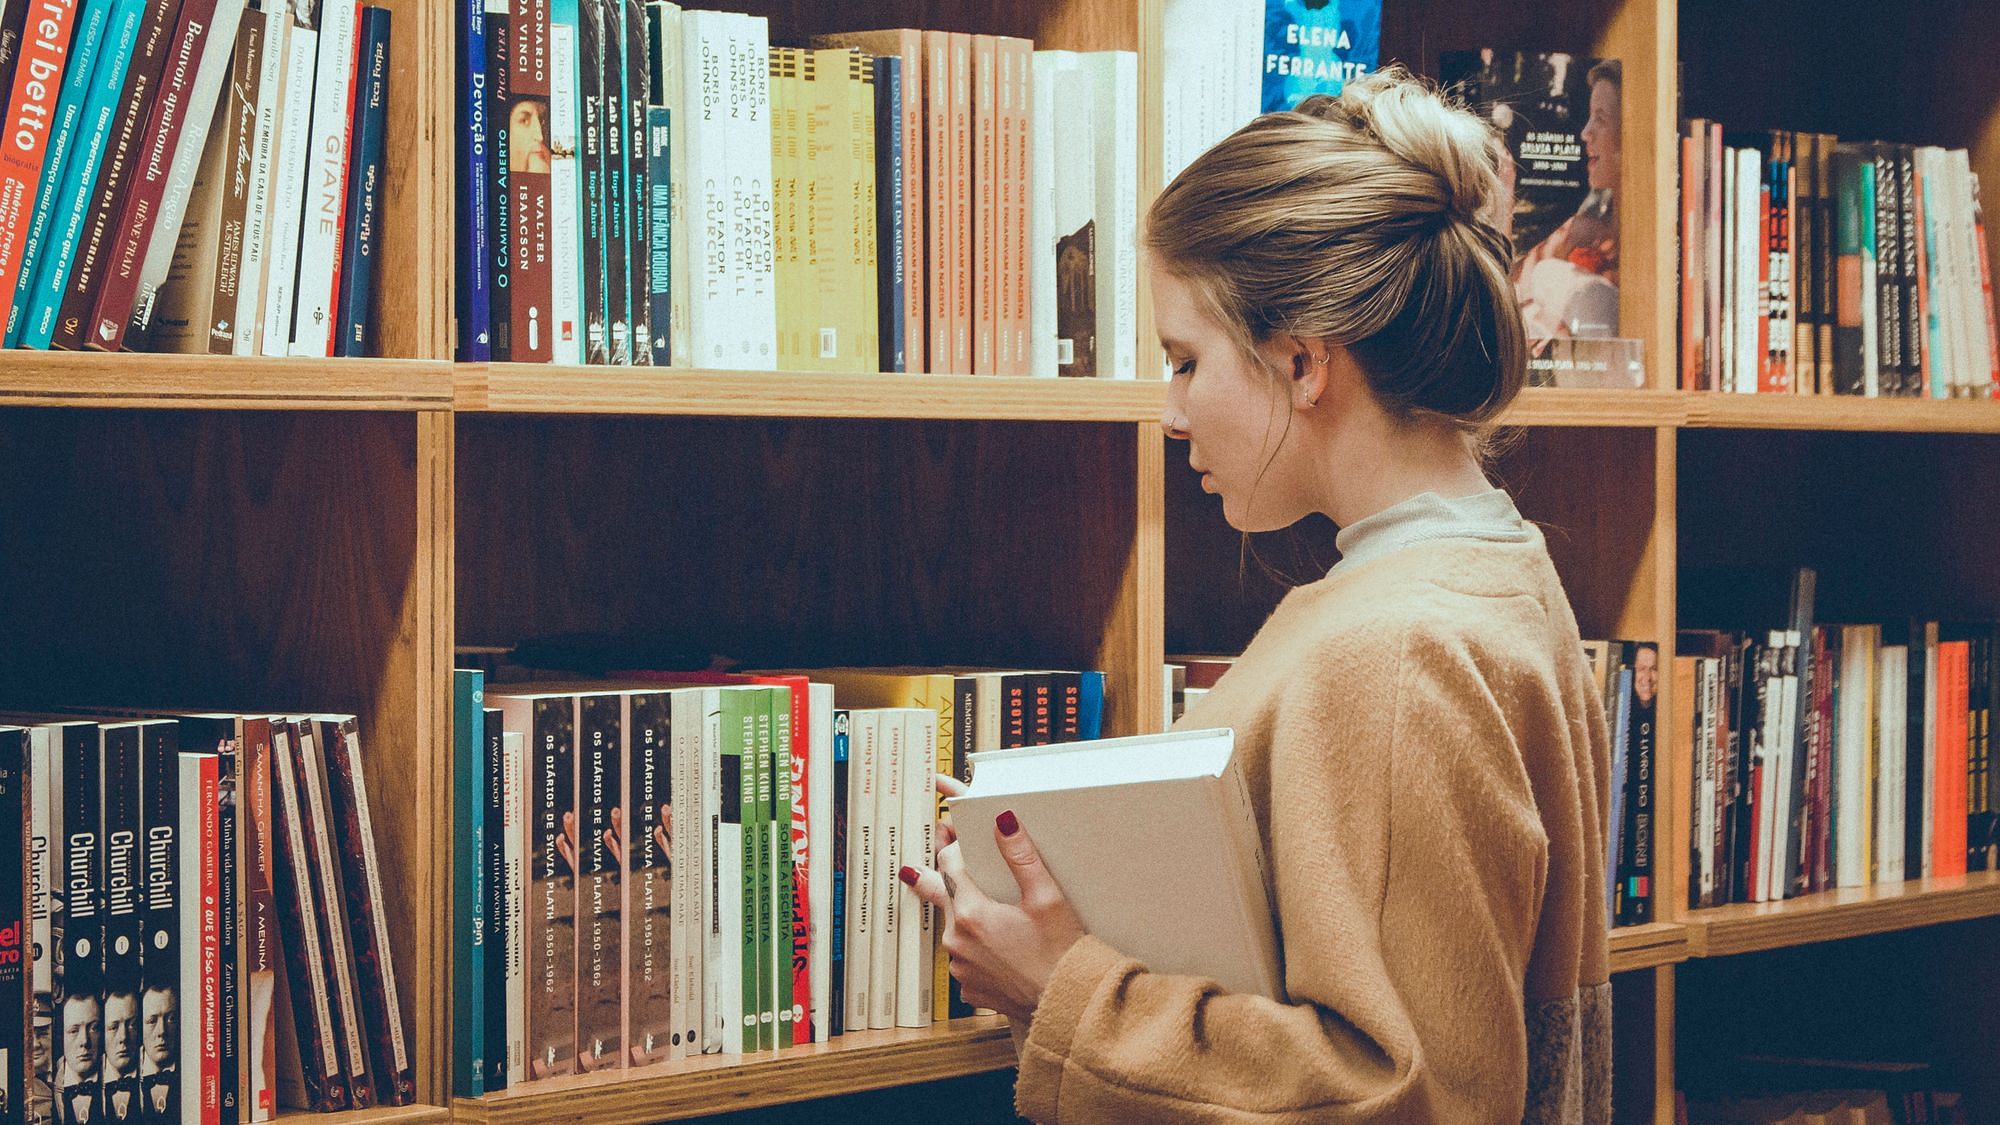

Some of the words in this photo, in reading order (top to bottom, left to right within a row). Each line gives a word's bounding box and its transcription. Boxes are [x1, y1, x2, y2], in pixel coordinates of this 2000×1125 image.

[84, 8, 102, 47] MELISSA
[119, 11, 136, 49] MELISSA
[1286, 24, 1351, 50] ELENA
[172, 19, 203, 90] Beauvoir
[372, 42, 384, 78] Forjaz
[519, 23, 528, 73] VINCI
[74, 48, 91, 88] FLEMING
[108, 50, 125, 90] FLEMING
[702, 36, 711, 121] JOHNSON
[711, 55, 720, 105] BORIS
[738, 53, 747, 102] BORIS
[1265, 54, 1367, 81] FERRANTE
[15, 58, 58, 151] betto
[264, 107, 272, 122] VAI
[370, 82, 380, 109] Teca
[470, 72, 485, 155] Devoção
[587, 96, 596, 123] Lab
[609, 96, 618, 123] Lab
[63, 104, 77, 131] Uma
[96, 106, 110, 132] Uma
[146, 92, 178, 182] apaixonada
[179, 124, 203, 174] Renato
[260, 124, 271, 160] EMBORA
[587, 126, 596, 155] Girl
[609, 126, 618, 155] Girl
[47, 130, 68, 184] esperança
[81, 132, 104, 185] esperança
[258, 163, 267, 175] DA
[498, 129, 507, 188] ABERTO
[40, 184, 56, 209] mais
[256, 178, 266, 201] CASA
[320, 134, 341, 237] GIANE
[365, 165, 375, 192] Gata
[589, 170, 597, 198] Hope
[652, 184, 669, 206] UMA
[75, 185, 90, 212] mais
[101, 190, 114, 208] DA
[162, 177, 187, 230] Aragão
[255, 204, 263, 215] DE
[364, 195, 373, 211] da
[716, 200, 724, 212] O
[743, 197, 752, 210] O
[32, 209, 50, 238] forte
[66, 213, 81, 240] forte
[231, 220, 241, 251] JAMES
[253, 219, 262, 240] TEUS
[498, 194, 508, 267] CAMINHO
[520, 185, 529, 271] ISAACSON
[536, 194, 544, 263] WALTER
[589, 201, 597, 239] Jahren
[652, 207, 669, 250] INFÂNCIA
[732, 176, 745, 297] CHURCHILL
[24, 238, 38, 259] que
[60, 239, 73, 260] que
[77, 212, 107, 293] LIBERDADE
[120, 240, 138, 278] FRAIN
[362, 244, 370, 256] O
[705, 179, 718, 301] CHURCHILL
[716, 221, 726, 275] FATOR
[743, 217, 753, 271] FATOR
[18, 266, 32, 291] mar
[52, 268, 65, 292] mar
[227, 252, 239, 297] EDWARD
[498, 274, 508, 288] O
[652, 251, 669, 294] ROUBADA
[964, 693, 974, 750] MEMÓRIAS
[1010, 688, 1022, 736] SCOTT
[1036, 687, 1048, 734] SCOTT
[1066, 687, 1077, 734] SCOTT
[1638, 722, 1649, 736] O
[492, 736, 500, 775] FAWZIA
[546, 735, 554, 750] OS
[593, 731, 602, 746] OS
[645, 729, 653, 744] OS
[743, 715, 754, 770] STEPHEN
[759, 714, 769, 769] STEPHEN
[779, 713, 789, 767] STEPHEN
[593, 751, 603, 804] DIÁRIOS
[645, 749, 655, 801] DIÁRIOS
[1638, 740, 1649, 781] LIVRO
[257, 743, 265, 817] SAMANTHA
[492, 777, 500, 808] KOOFI
[546, 756, 556, 808] DIÁRIOS
[743, 774, 754, 803] KING
[759, 772, 769, 802] KING
[779, 771, 789, 800] KING
[1638, 784, 1649, 808] DO
[205, 779, 214, 837] FERNANDO
[546, 814, 554, 829] DE
[593, 809, 602, 824] DE
[645, 806, 653, 821] DE
[223, 818, 233, 850] Minha
[257, 821, 265, 872] GEIMER
[593, 829, 602, 871] SYLVIA
[645, 826, 653, 868] SYLVIA
[744, 826, 753, 871] SOBRE
[760, 824, 769, 869] SOBRE
[110, 831, 133, 916] Churchill
[206, 840, 214, 887] GABEIRA
[223, 852, 233, 874] vida
[546, 834, 554, 877] SYLVIA
[71, 832, 94, 918] Churchill
[223, 876, 233, 905] como
[645, 873, 653, 910] PLATH
[744, 875, 753, 885] A
[760, 873, 769, 883] A
[205, 895, 215, 905] O
[257, 902, 264, 912] A
[546, 882, 554, 920] PLATH
[593, 876, 602, 914] PLATH
[205, 909, 215, 932] QUE
[223, 907, 233, 946] traidora
[473, 917, 484, 946] Luigi
[744, 888, 753, 945] ESCRITA
[760, 886, 769, 943] ESCRITA
[258, 916, 266, 972] MENINA
[546, 927, 554, 993] 1950-1962
[593, 921, 602, 986] 1950-1962
[645, 918, 653, 982] 1950-1962
[224, 962, 234, 992] Zarah
[205, 976, 215, 1059] COMPANHEIRO?
[224, 996, 234, 1058] Ghahramani
